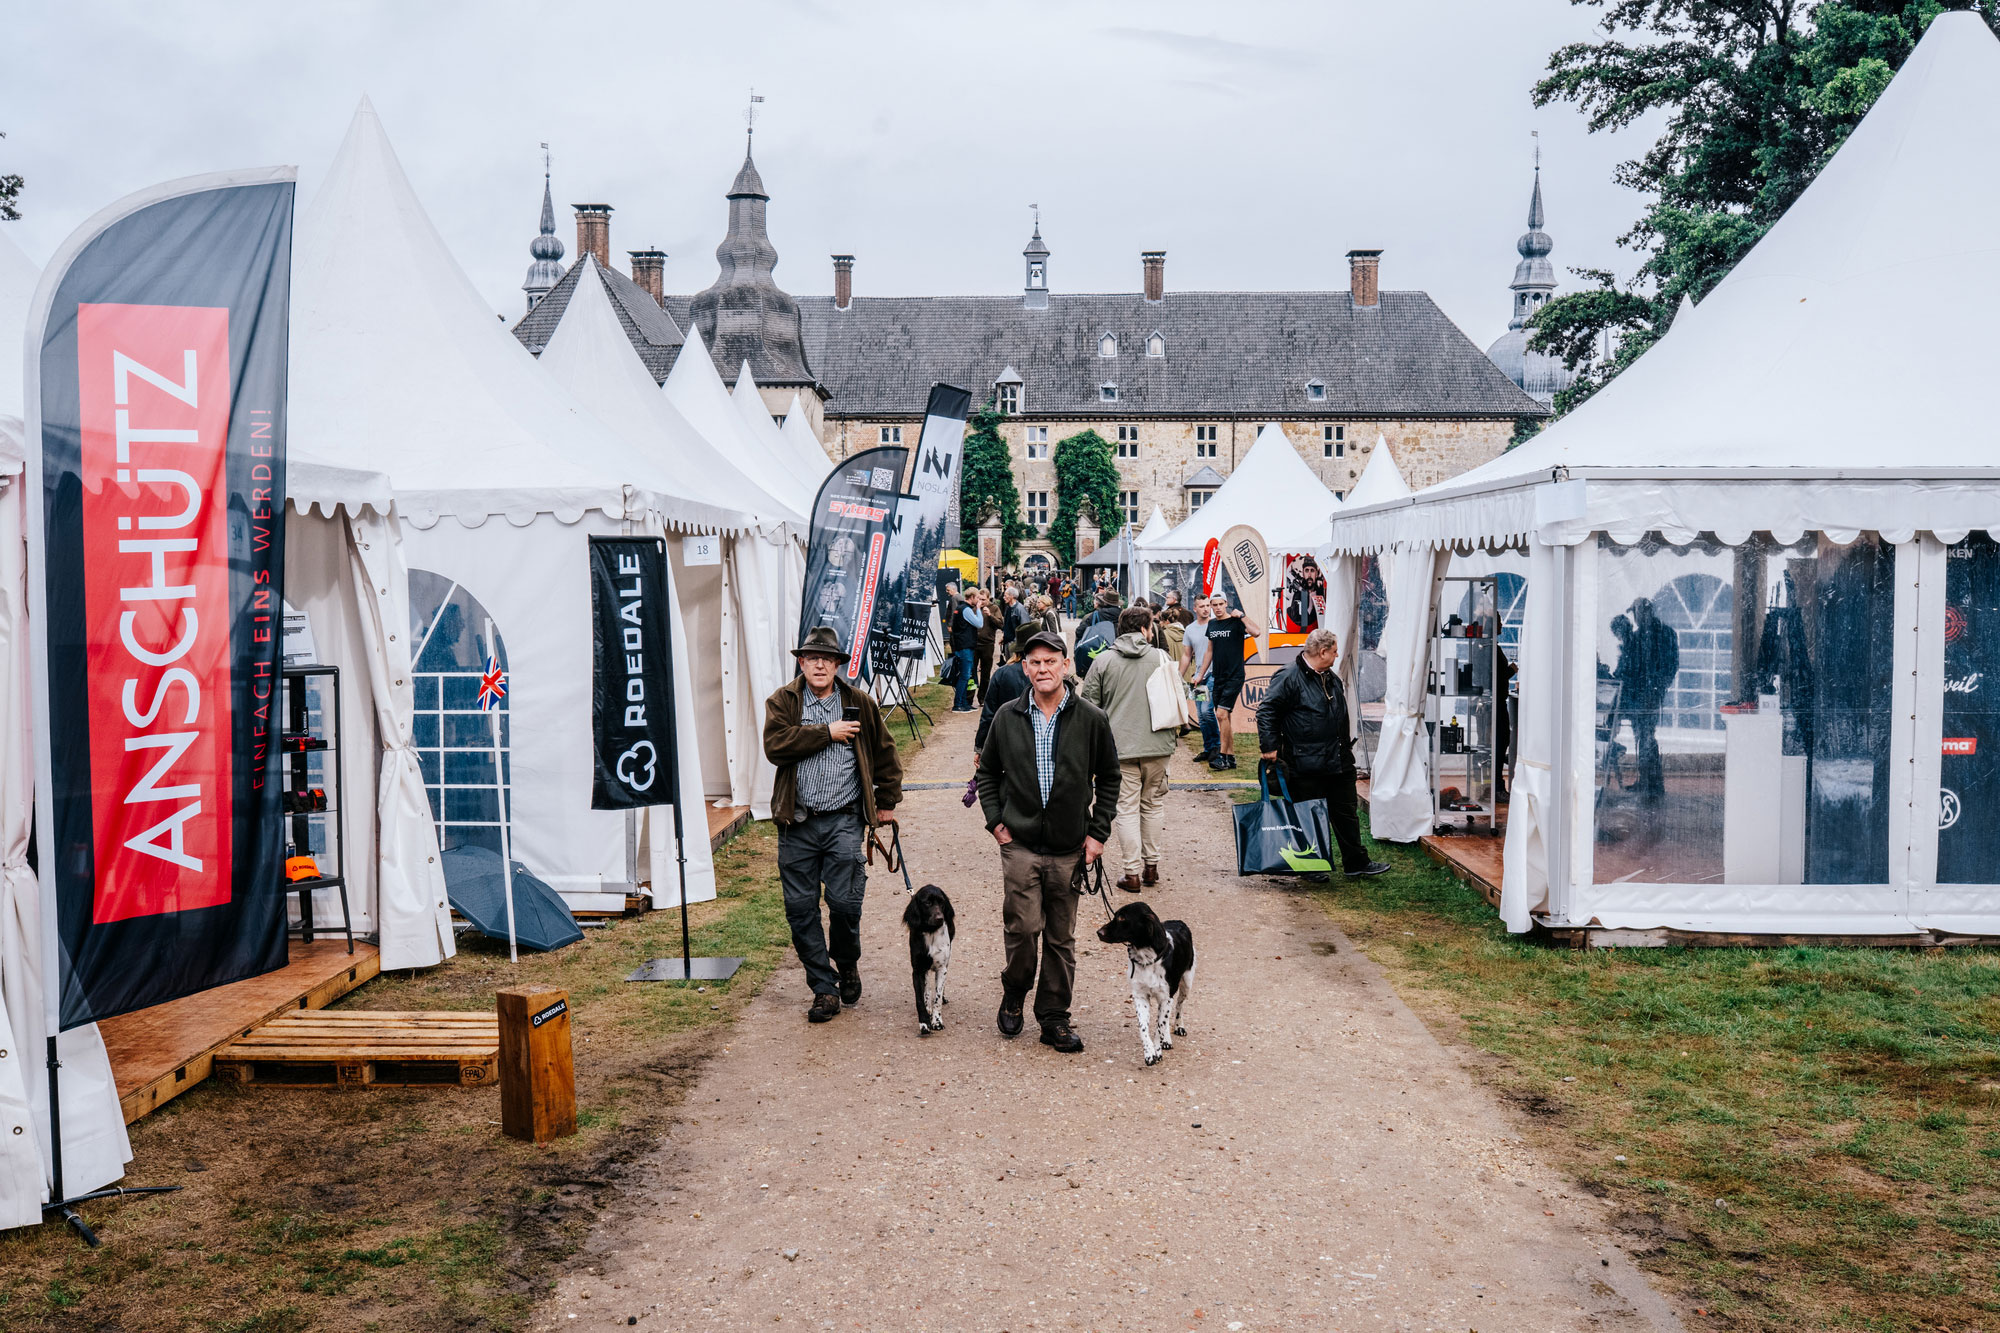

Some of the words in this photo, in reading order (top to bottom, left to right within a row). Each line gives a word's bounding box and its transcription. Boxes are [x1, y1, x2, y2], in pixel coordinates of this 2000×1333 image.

[249, 408, 273, 550] WERDEN!
[916, 480, 950, 495] NOSLA
[696, 544, 709, 555] 18
[1206, 547, 1219, 586] MINOX
[113, 349, 203, 872] ANSCHÜTZ
[253, 568, 271, 643] EINS
[619, 553, 648, 727] ROEDALE
[900, 626, 925, 636] HING
[1209, 630, 1231, 639] ESPRIT
[252, 661, 272, 790] EINFACH
[541, 1002, 566, 1020] ROEDALE
